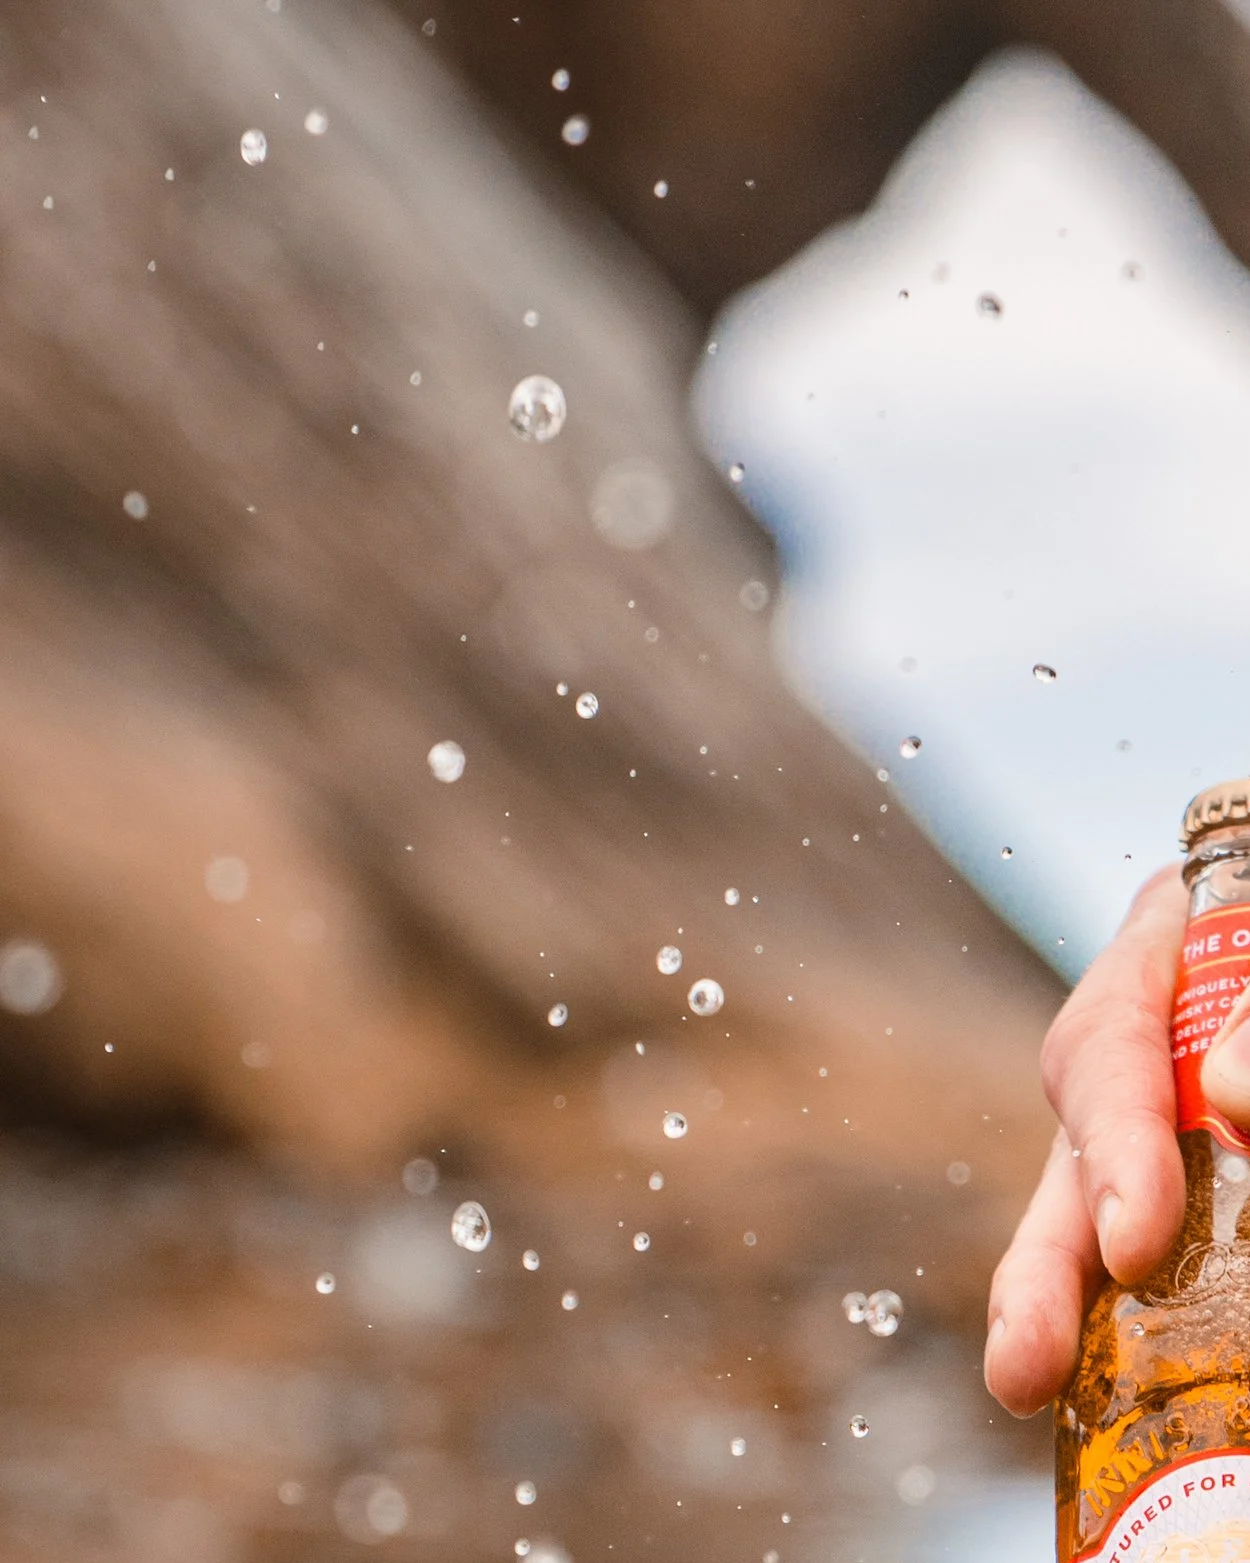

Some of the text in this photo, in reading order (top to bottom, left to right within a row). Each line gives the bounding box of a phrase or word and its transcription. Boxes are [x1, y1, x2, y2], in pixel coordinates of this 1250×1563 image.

[1184, 933, 1221, 963] THE
[1176, 1016, 1226, 1041] DELICI
[1183, 1473, 1236, 1498] FOR
